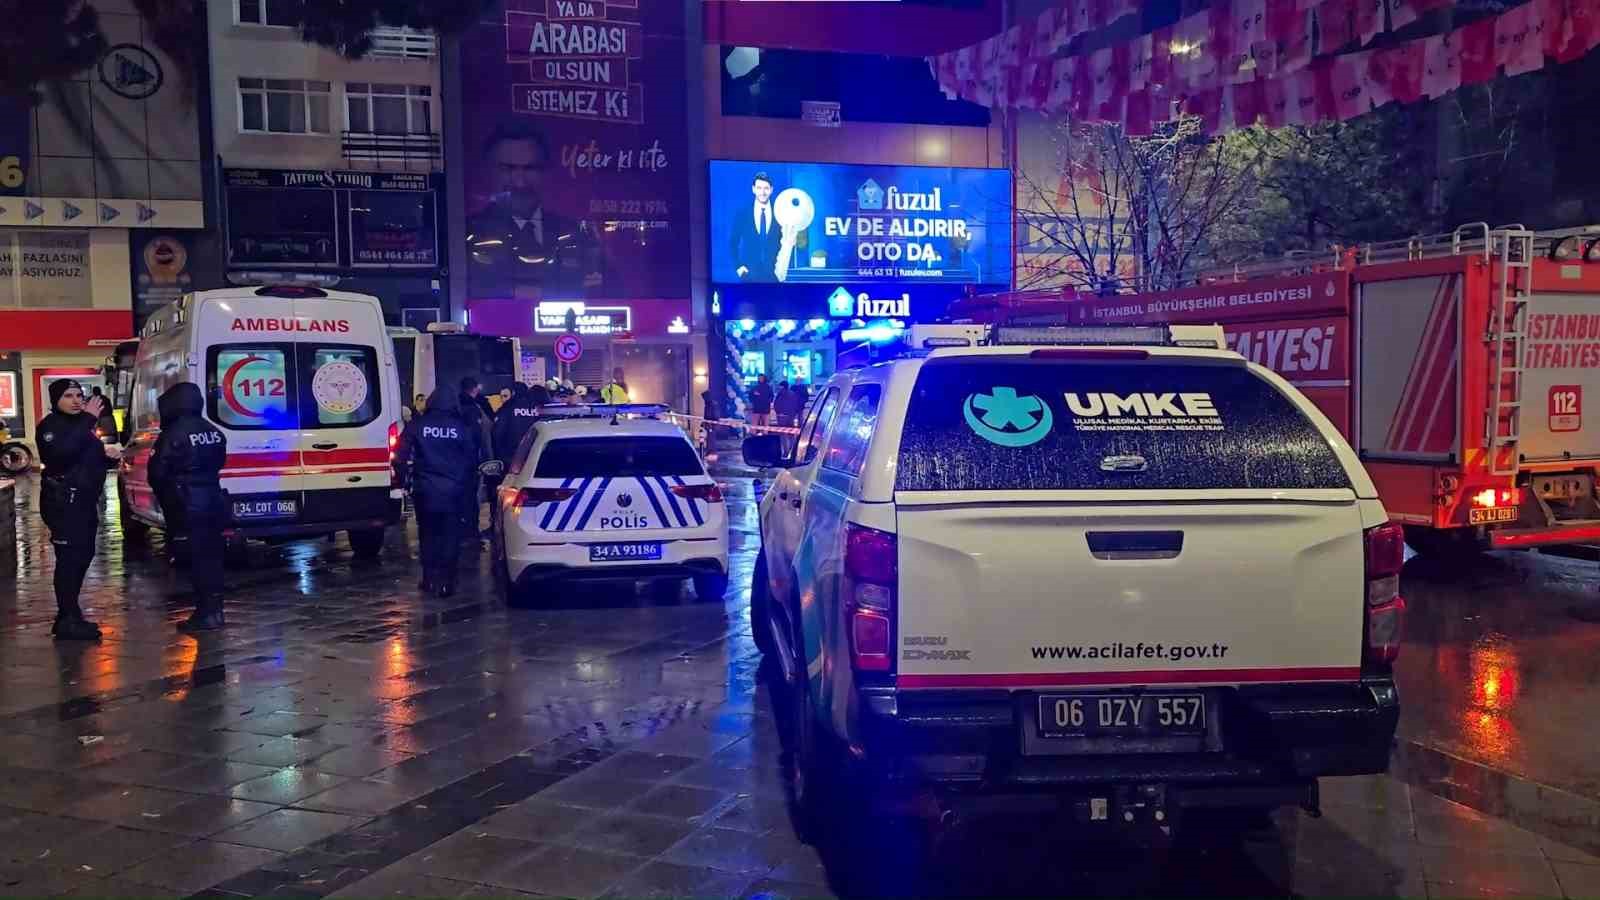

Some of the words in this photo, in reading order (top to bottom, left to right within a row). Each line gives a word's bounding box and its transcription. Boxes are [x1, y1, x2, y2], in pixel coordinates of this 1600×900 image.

[556, 0, 575, 17] YA
[578, 2, 595, 17] DA
[529, 21, 626, 54] ARABASI
[545, 61, 611, 83] OLSUN
[527, 89, 598, 115] İSTEMEZ
[604, 91, 628, 118] Kİ
[885, 186, 942, 211] fuzul
[825, 216, 851, 236] EV
[856, 217, 884, 236] DE
[888, 218, 972, 241] ALDIRIR,
[857, 242, 902, 262] OTO
[856, 292, 911, 317] fuzul
[1093, 305, 1144, 318] İSTANBUL
[1147, 296, 1225, 314] BÜYÜKŞEHİR
[1229, 285, 1313, 306] BELEDİYESİ
[230, 318, 350, 333] AMBULANS
[238, 378, 285, 397] 112
[1064, 392, 1219, 417] UMKE
[1553, 391, 1577, 414] 112
[600, 512, 648, 529] POLİS
[594, 546, 609, 556] 34
[610, 545, 621, 556] A
[623, 544, 657, 556] 93186
[1031, 642, 1229, 661] www.acilafet.gov.tr
[1055, 699, 1085, 727] 06
[1098, 698, 1144, 727] DZY
[1158, 698, 1201, 726] 557
